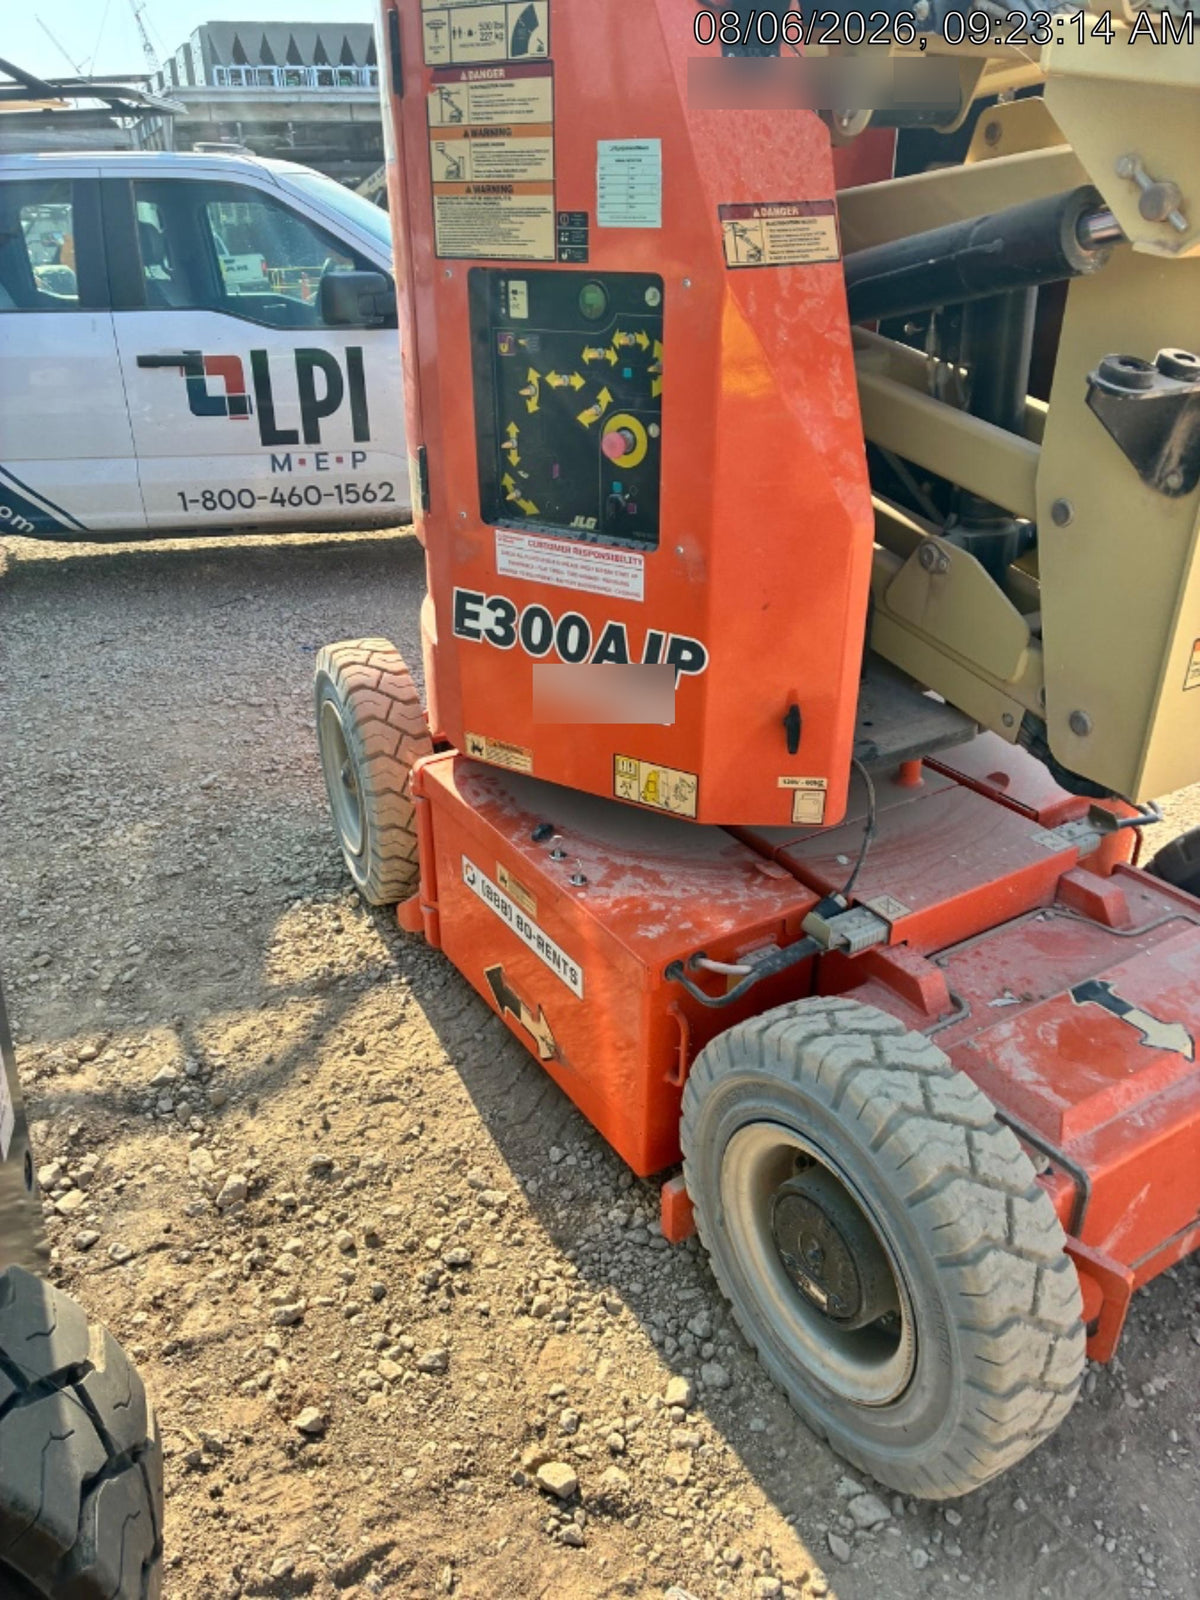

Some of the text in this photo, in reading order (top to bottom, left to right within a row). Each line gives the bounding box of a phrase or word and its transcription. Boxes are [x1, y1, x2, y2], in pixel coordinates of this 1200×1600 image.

[467, 68, 506, 80] DANGER
[470, 127, 512, 138] WARNING
[472, 184, 514, 194] WARNING
[760, 206, 799, 217] DANGER
[249, 346, 371, 447] LPI
[177, 481, 396, 511] 1-800-460-1562
[569, 514, 598, 530] JLG
[527, 539, 571, 554] CUSTOMER
[571, 545, 642, 566] RESPONSIBILITY
